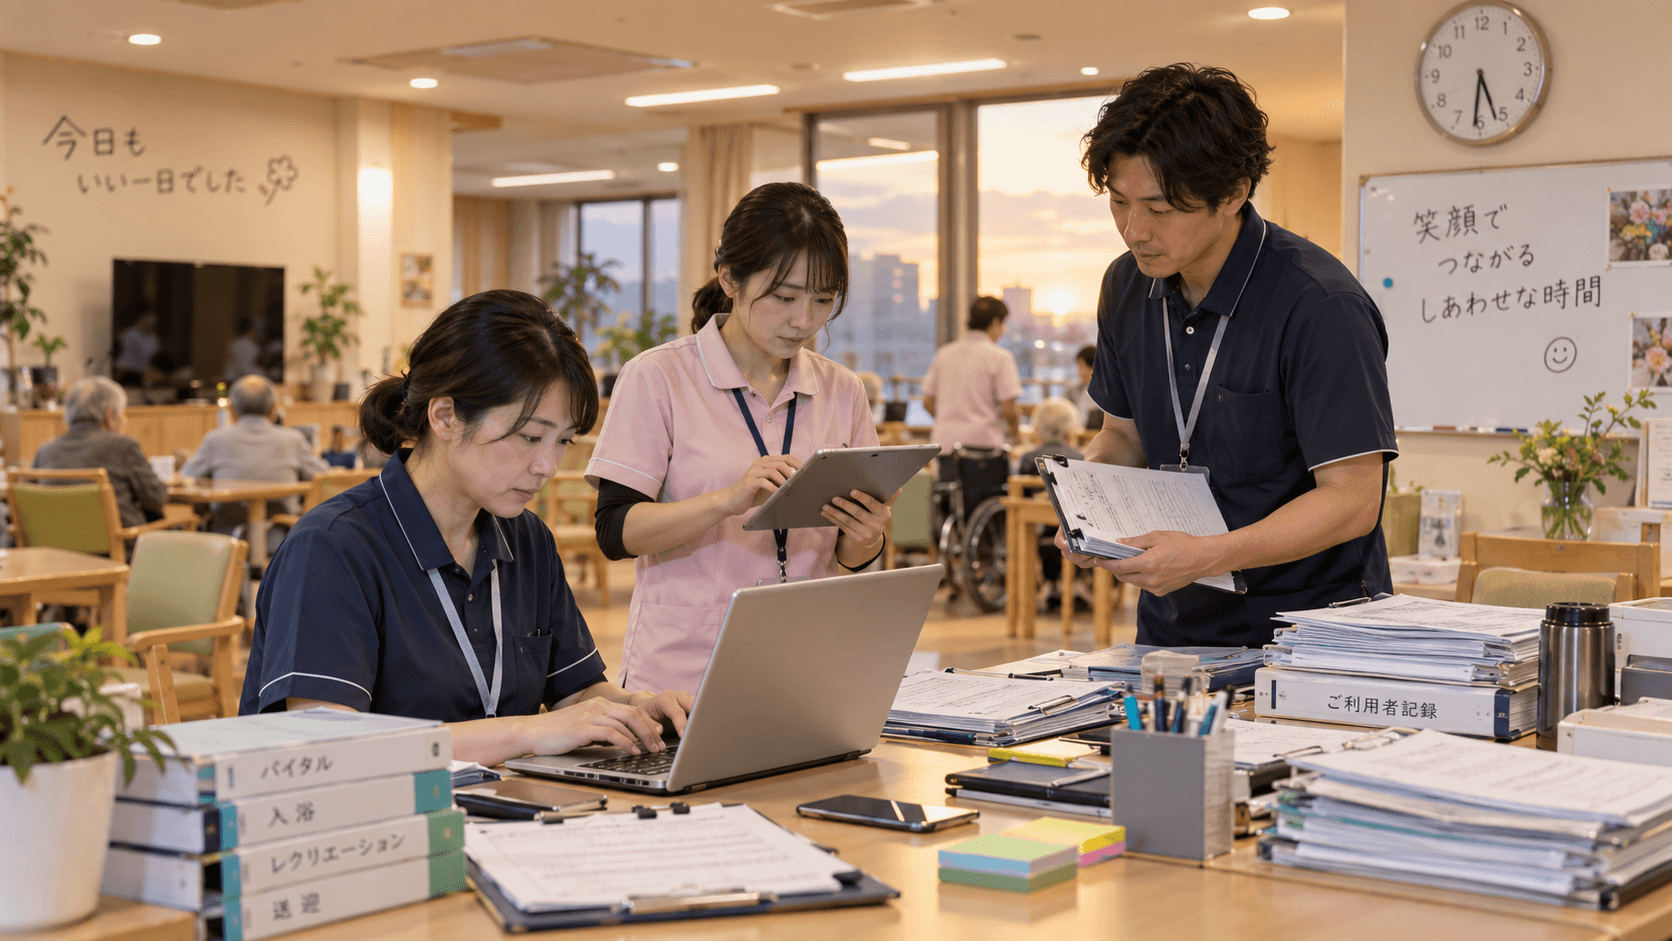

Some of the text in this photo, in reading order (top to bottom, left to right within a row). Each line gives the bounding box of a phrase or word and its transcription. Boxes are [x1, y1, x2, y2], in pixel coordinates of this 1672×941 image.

[1475, 16, 1489, 31] 12
[1454, 25, 1465, 39] 11
[1438, 44, 1452, 59] 10
[1517, 37, 1526, 52] 2
[1431, 69, 1440, 84] 9
[1523, 62, 1533, 77] 3
[1437, 93, 1446, 108] 8
[1515, 87, 1525, 102] 4
[1454, 110, 1463, 125] 7
[1498, 107, 1508, 122] 5
[1476, 115, 1485, 130] 6
[42, 115, 146, 160] 今日も
[77, 167, 247, 194] いい一日でした
[1413, 204, 1508, 244] 笑顔で
[1438, 243, 1535, 275] つながる
[1421, 275, 1602, 323] しあわせな時間
[1327, 694, 1438, 720] ご利用者記録
[261, 755, 334, 779] バイタル
[268, 802, 316, 828] 入浴
[271, 834, 406, 874] レクリエーション
